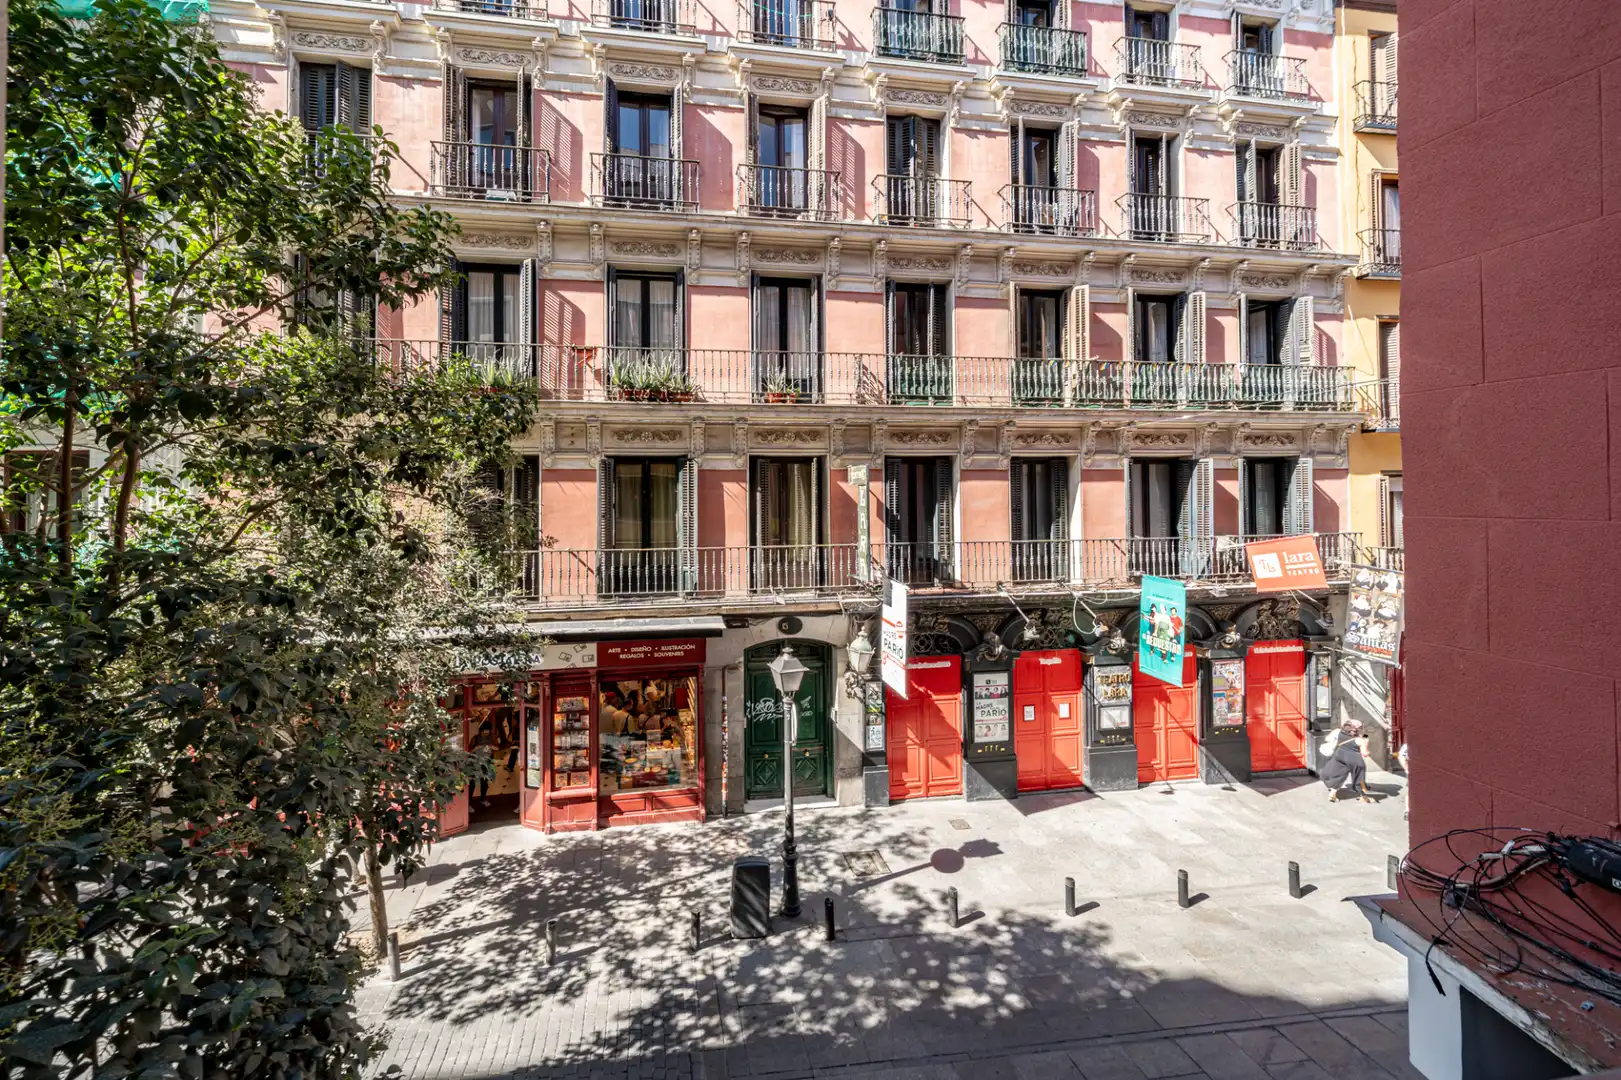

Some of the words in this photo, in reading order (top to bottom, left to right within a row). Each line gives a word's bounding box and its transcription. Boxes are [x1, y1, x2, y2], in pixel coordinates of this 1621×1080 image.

[1282, 551, 1315, 564] lara
[1287, 567, 1320, 577] TEATRO
[630, 645, 652, 653] DISEÑO
[661, 643, 696, 651] ILUSTRACIÓN
[1103, 687, 1127, 698] LARA
